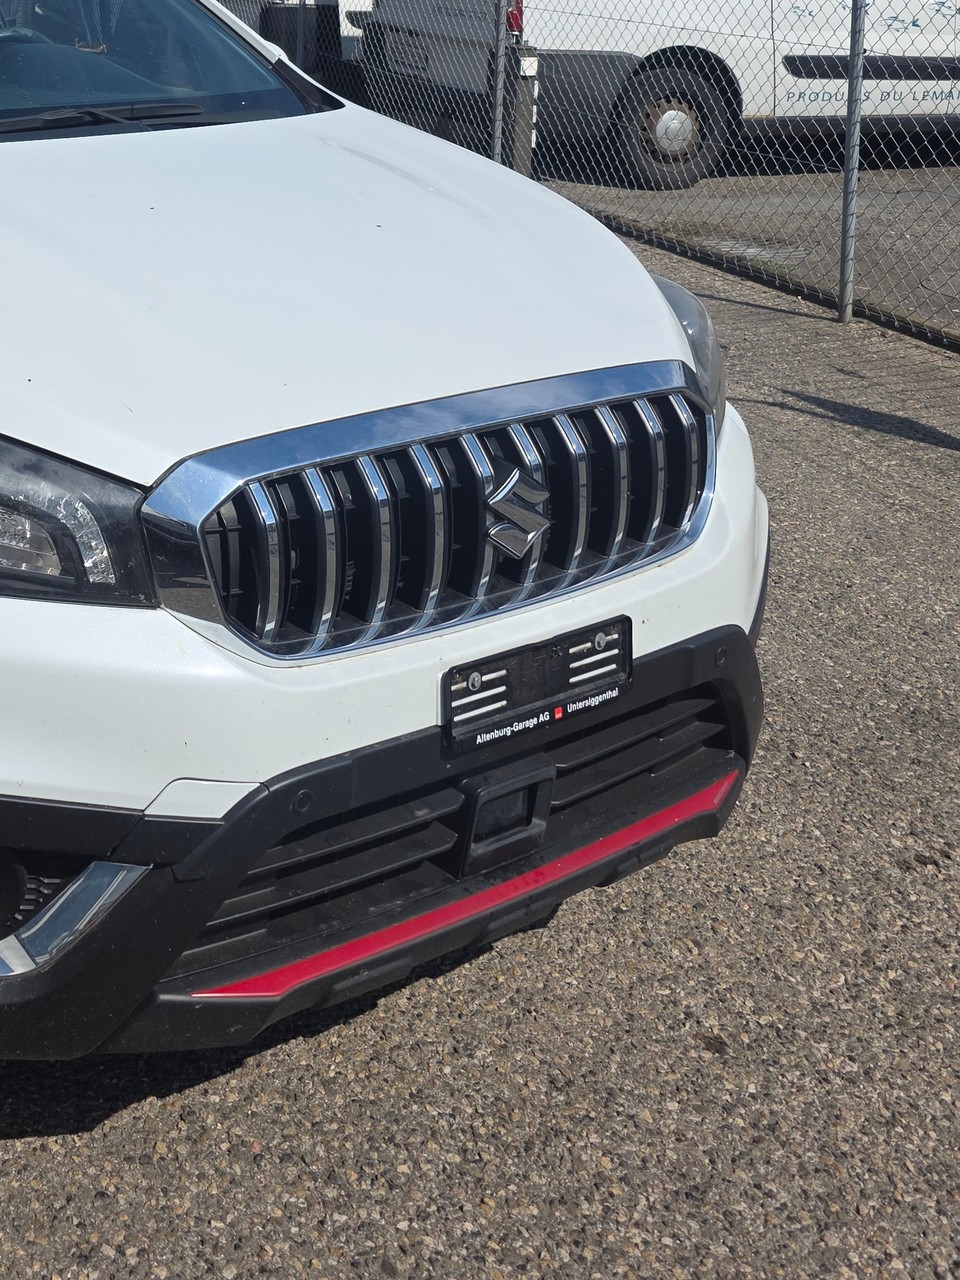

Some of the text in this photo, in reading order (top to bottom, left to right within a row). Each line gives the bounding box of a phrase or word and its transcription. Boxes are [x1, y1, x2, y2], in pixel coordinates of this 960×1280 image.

[786, 91, 871, 102] PRODUS
[880, 91, 903, 102] DU
[476, 687, 619, 744] Altenburg-Garage AG Untersiggenthal
